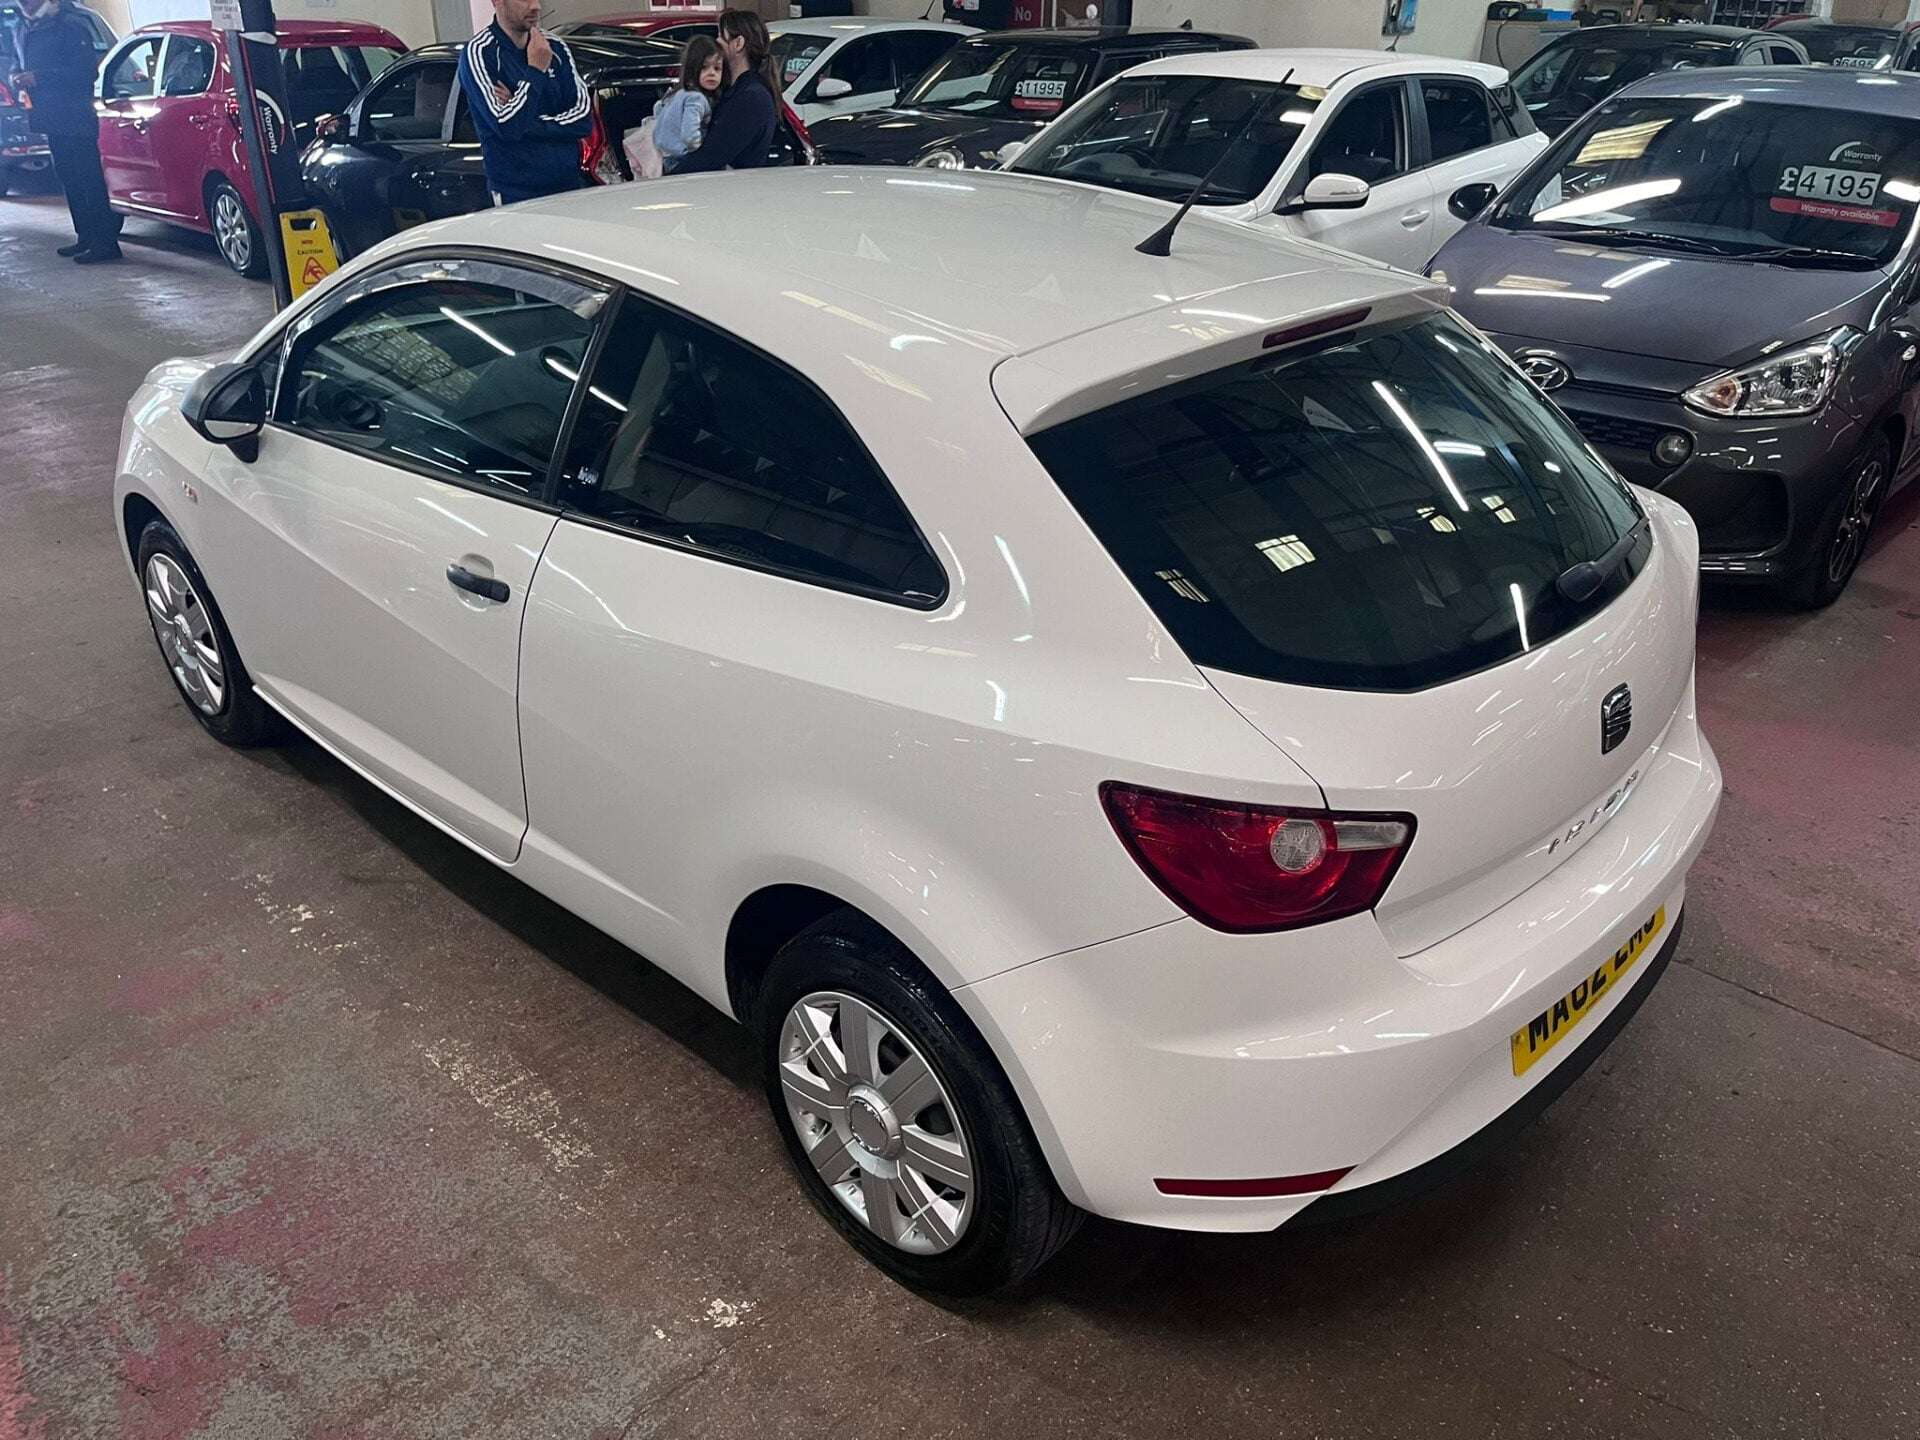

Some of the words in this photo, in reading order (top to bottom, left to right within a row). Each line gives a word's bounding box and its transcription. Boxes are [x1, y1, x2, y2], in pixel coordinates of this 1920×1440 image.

[1014, 81, 1064, 96] £11995
[263, 106, 278, 155] Warranty
[1843, 150, 1883, 162] Warranty
[1779, 166, 1877, 200] £4195
[1800, 203, 1839, 217] Warranty
[1840, 209, 1881, 221] available
